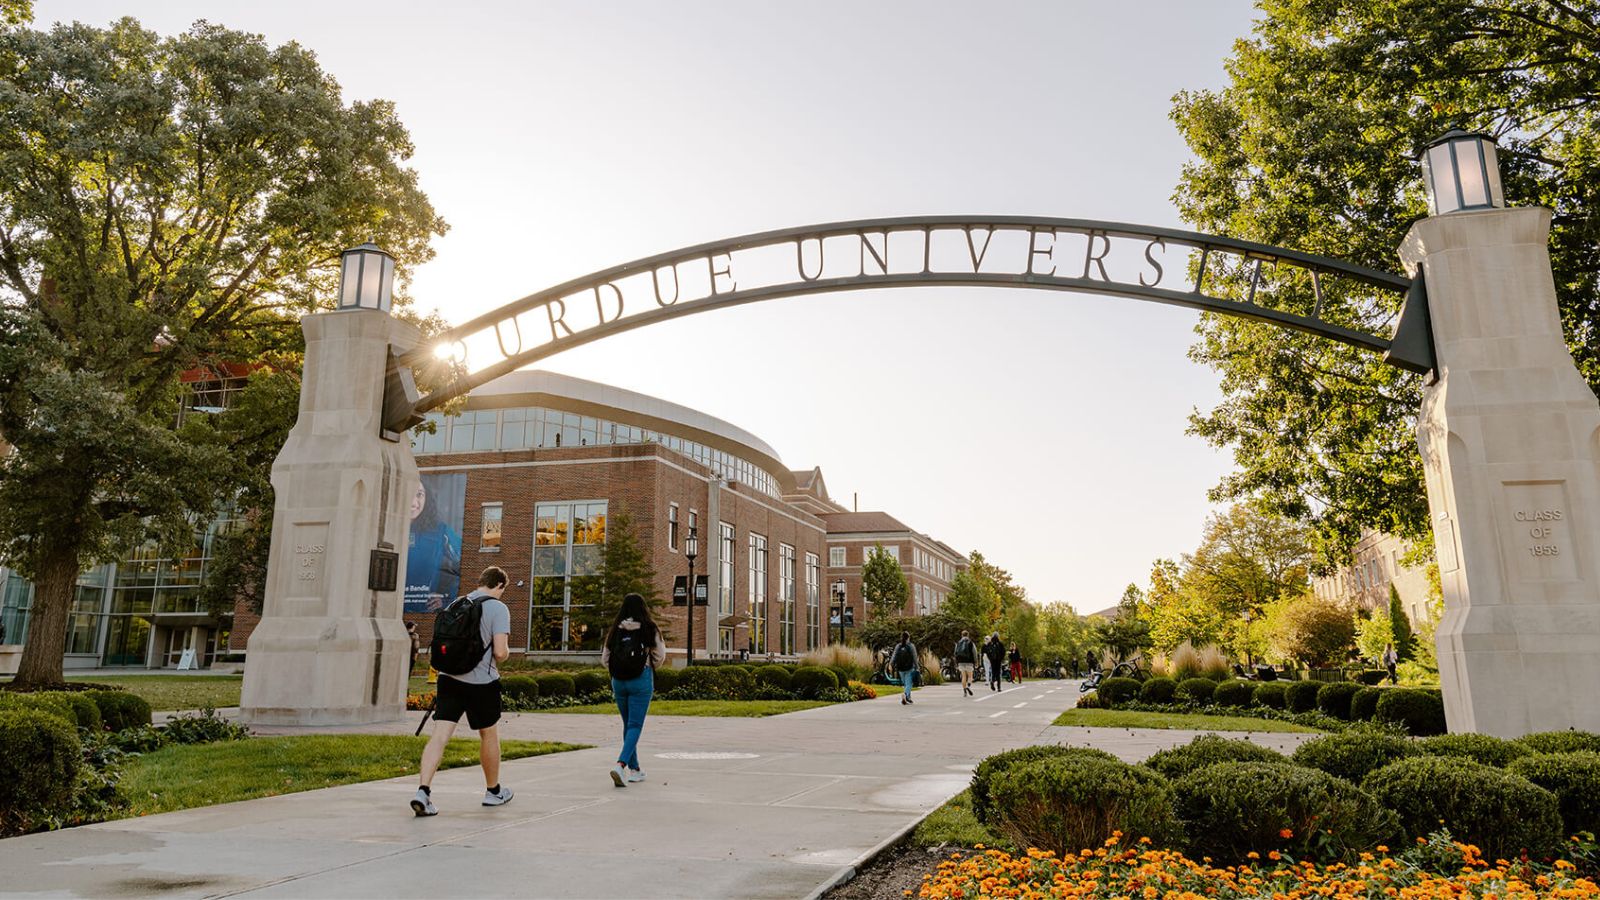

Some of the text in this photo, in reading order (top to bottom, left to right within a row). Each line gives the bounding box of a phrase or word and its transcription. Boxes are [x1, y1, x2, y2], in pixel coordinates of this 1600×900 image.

[796, 226, 1343, 318] UNIVERSITY
[1514, 510, 1562, 521] CLASS
[1530, 527, 1551, 539] OF
[296, 543, 325, 554] CLASS
[1530, 544, 1558, 556] 1959
[302, 558, 315, 567] OF
